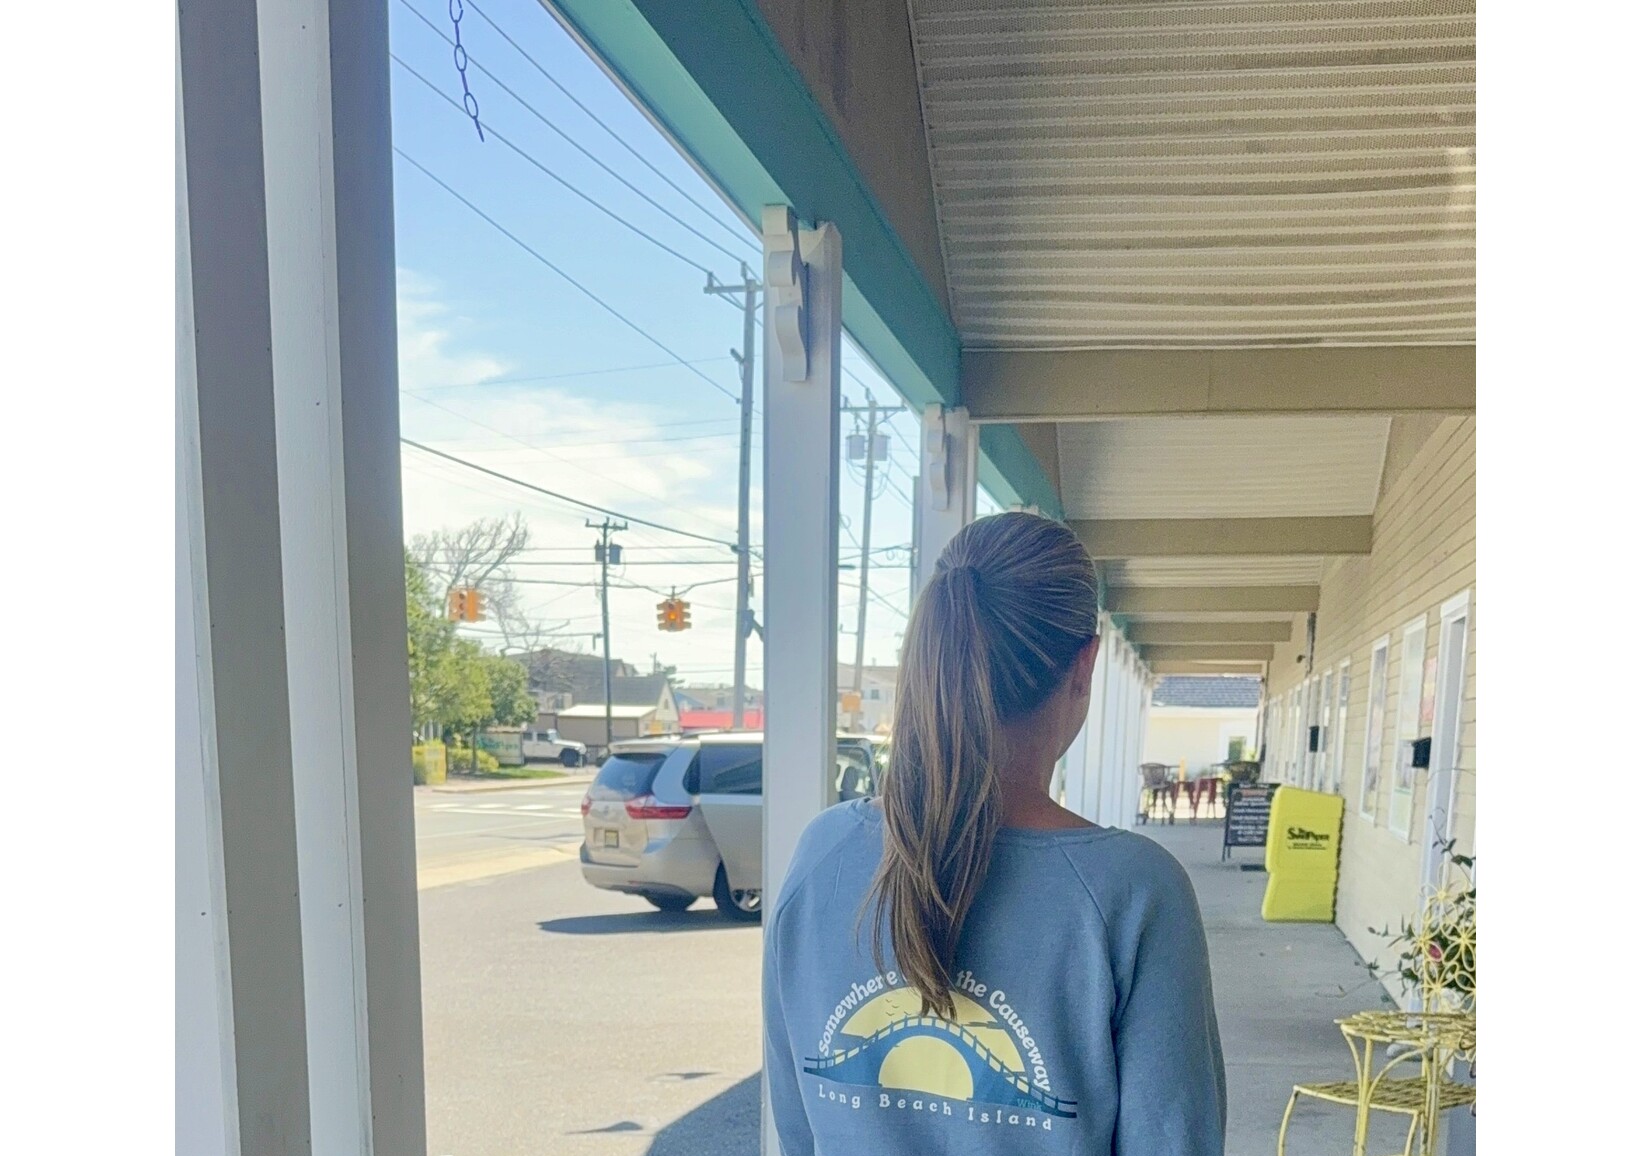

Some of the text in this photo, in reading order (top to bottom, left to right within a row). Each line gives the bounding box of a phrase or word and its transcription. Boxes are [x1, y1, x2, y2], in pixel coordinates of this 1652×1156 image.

[818, 970, 1051, 1092] somewhere the Causeway
[818, 1083, 1052, 1131] Long Beach Island
